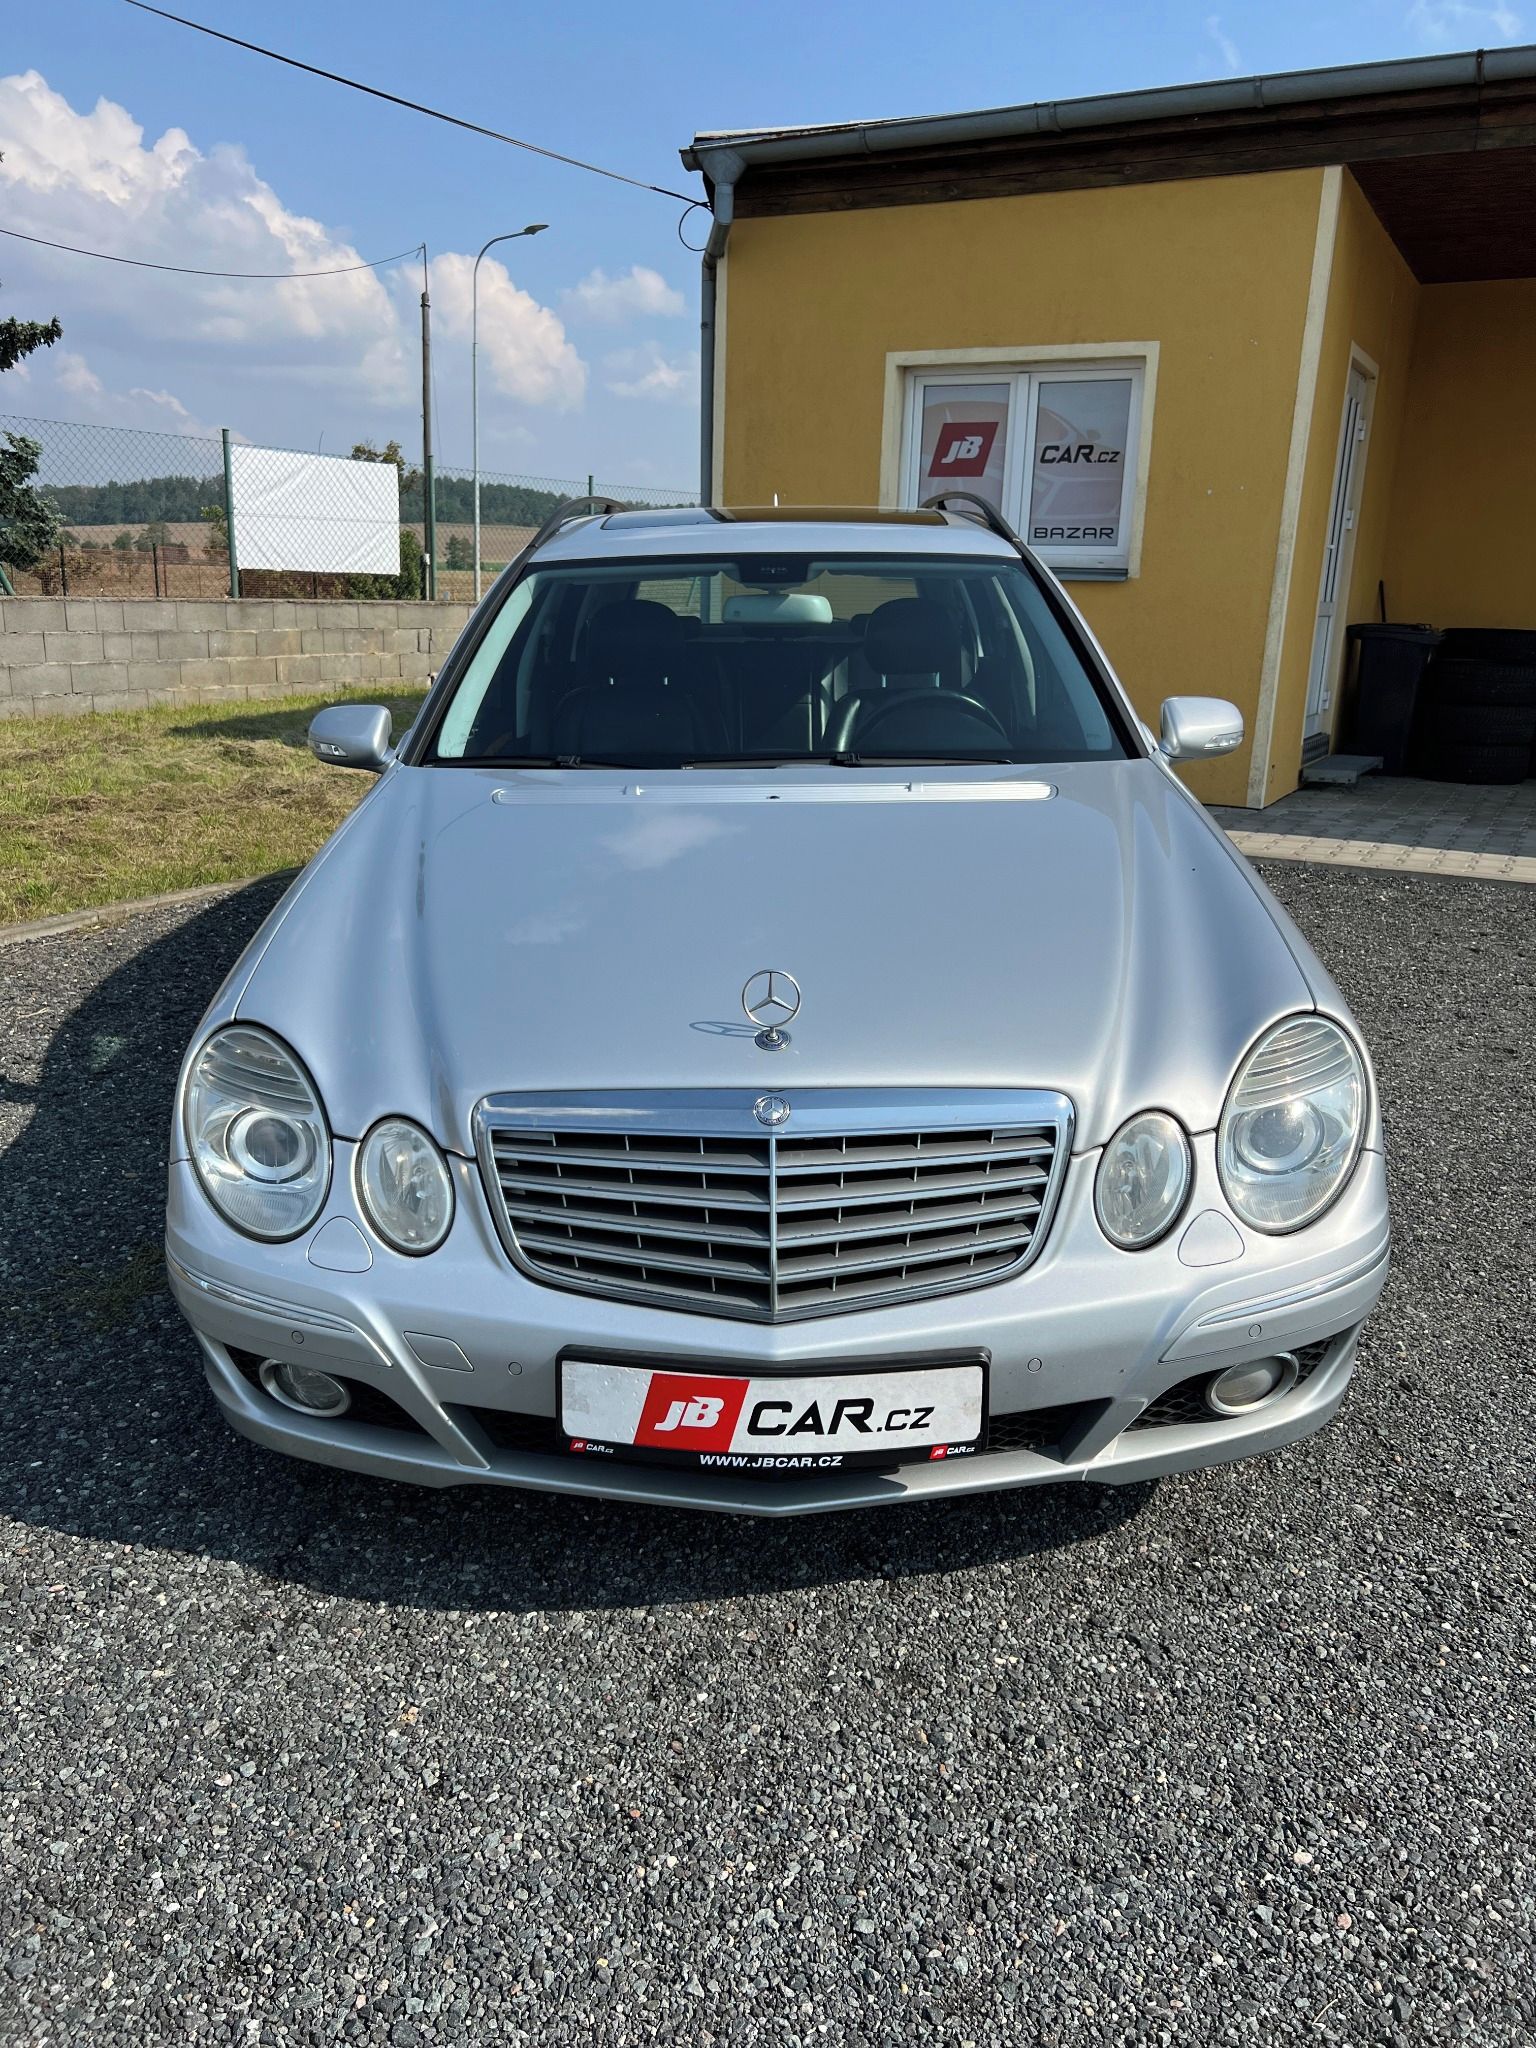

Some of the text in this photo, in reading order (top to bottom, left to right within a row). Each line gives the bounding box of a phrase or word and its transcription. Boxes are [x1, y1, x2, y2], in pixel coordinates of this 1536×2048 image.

[940, 436, 984, 464] JB
[1034, 527, 1115, 539] BAZAR
[653, 1396, 725, 1431] JB
[699, 1454, 844, 1468] WWW.JBCAR.CZ
